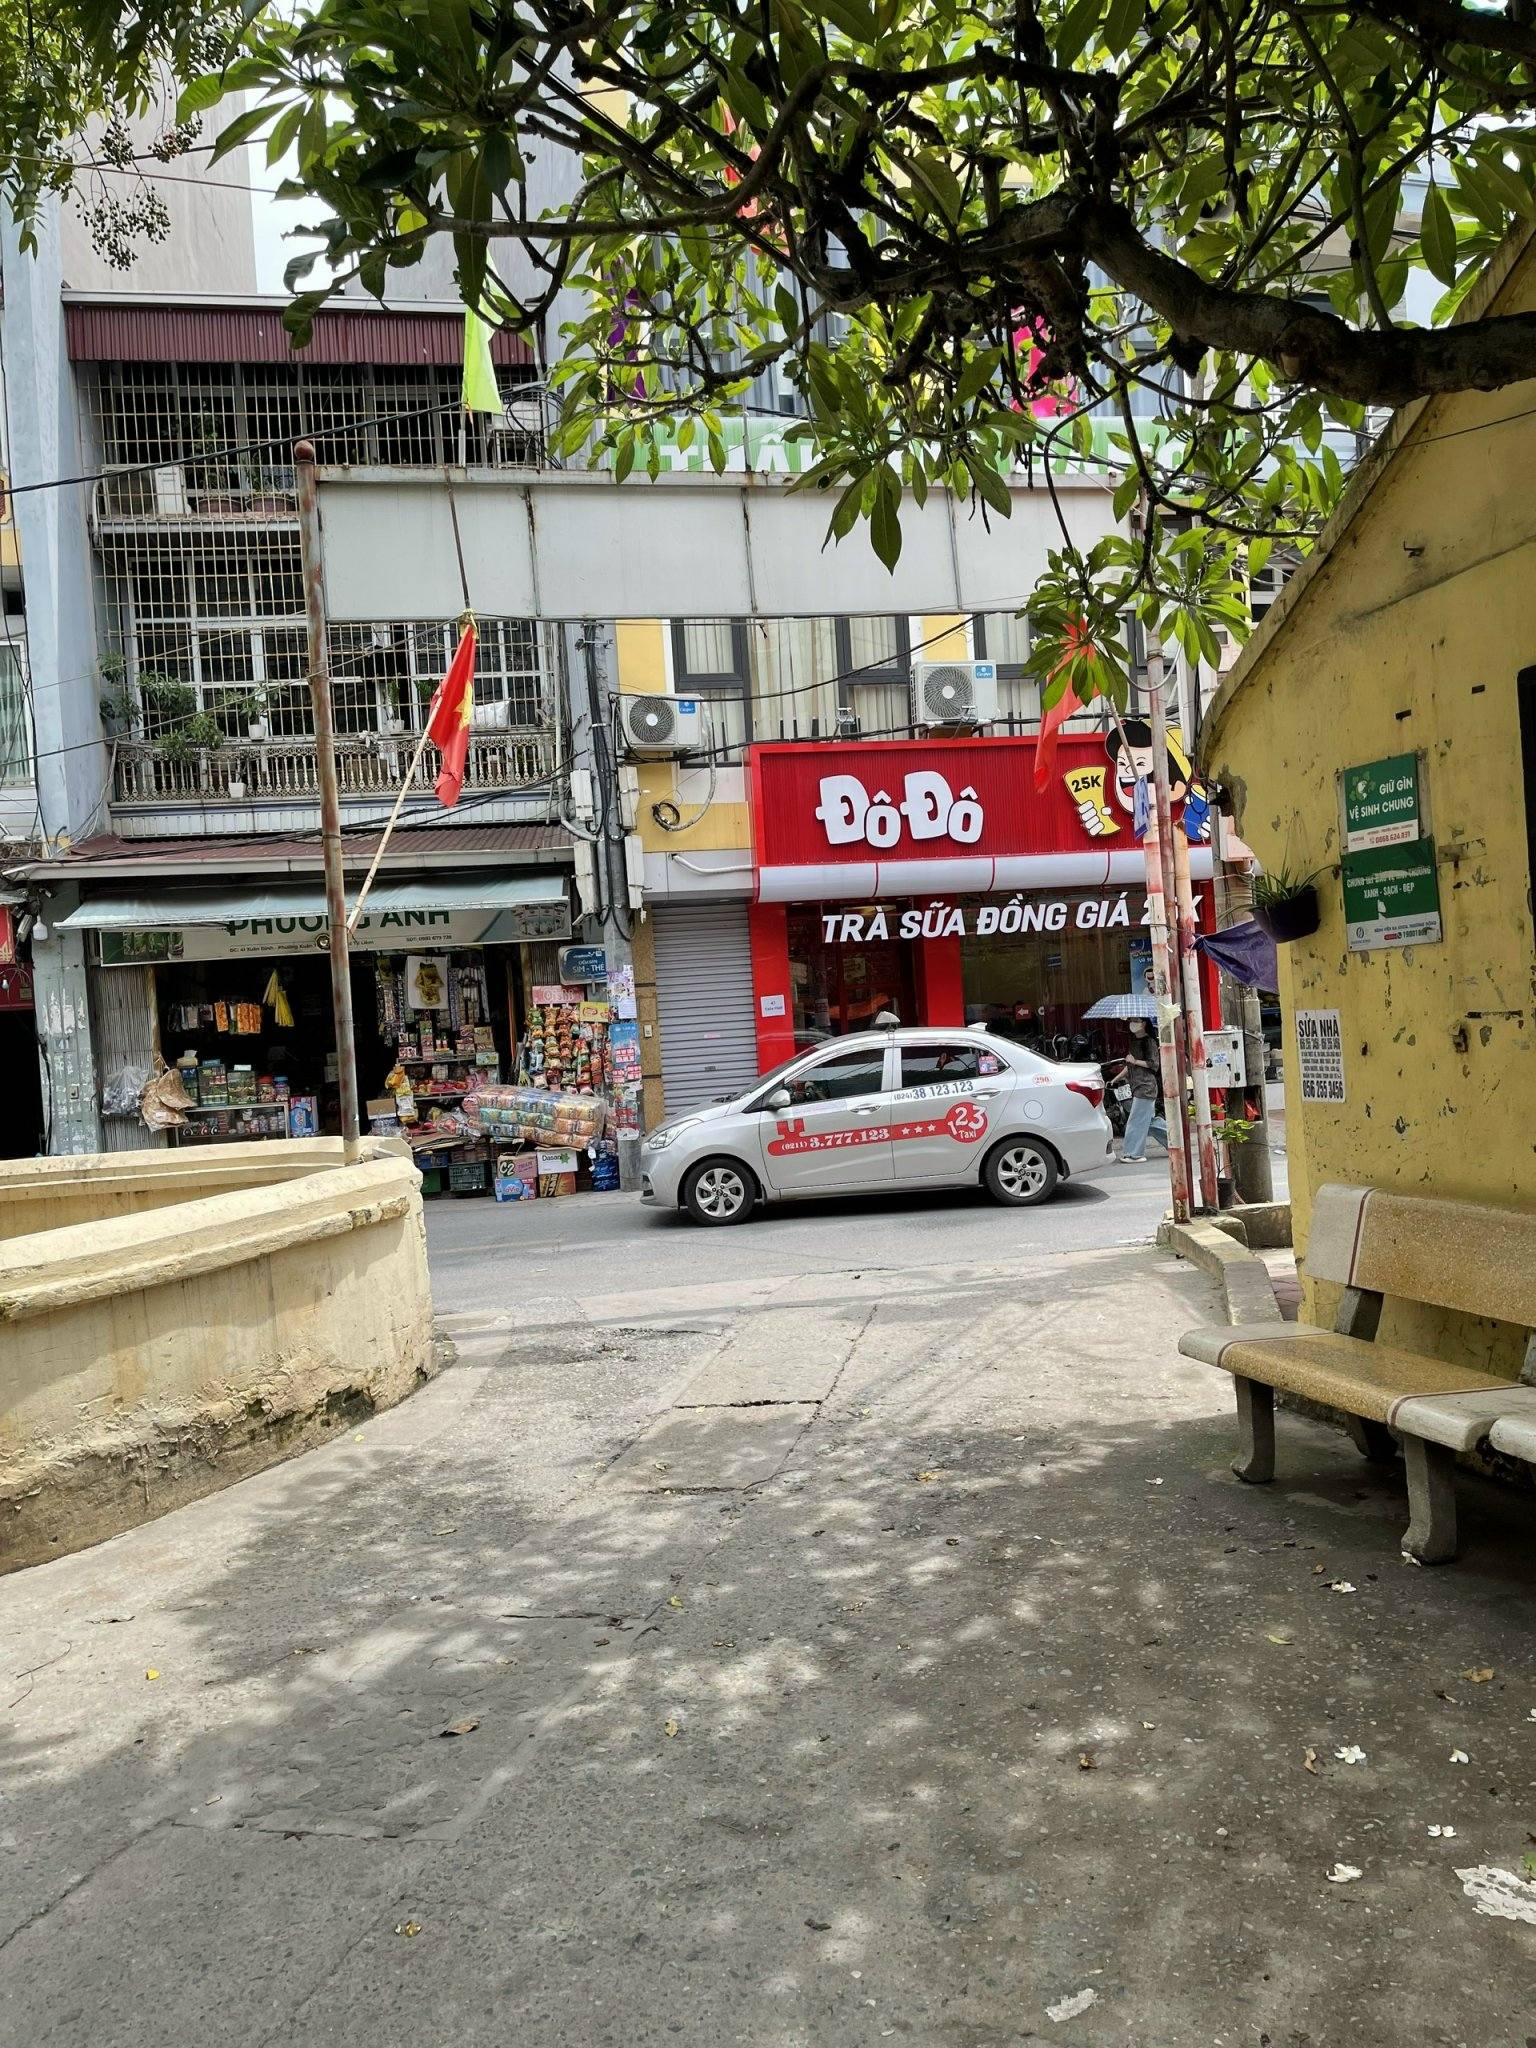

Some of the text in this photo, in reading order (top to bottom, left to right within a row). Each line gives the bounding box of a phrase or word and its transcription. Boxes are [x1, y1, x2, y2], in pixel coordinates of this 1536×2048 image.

[1071, 775, 1101, 793] 25K
[1379, 776, 1413, 795] GIỮ GÌN
[1349, 796, 1414, 821] VỆ SINH CHUNG
[1383, 885, 1399, 897] SẠCH
[821, 892, 1204, 944] TRÀ SỮA ĐỒNG GIÁ 2K
[1298, 1012, 1339, 1037] SỬA NHÀ
[947, 1105, 987, 1136] 123
[809, 1128, 890, 1149] 3.777.123
[959, 1129, 977, 1140] Taxi
[541, 1154, 563, 1162] Dasan
[499, 1161, 515, 1176] C2
